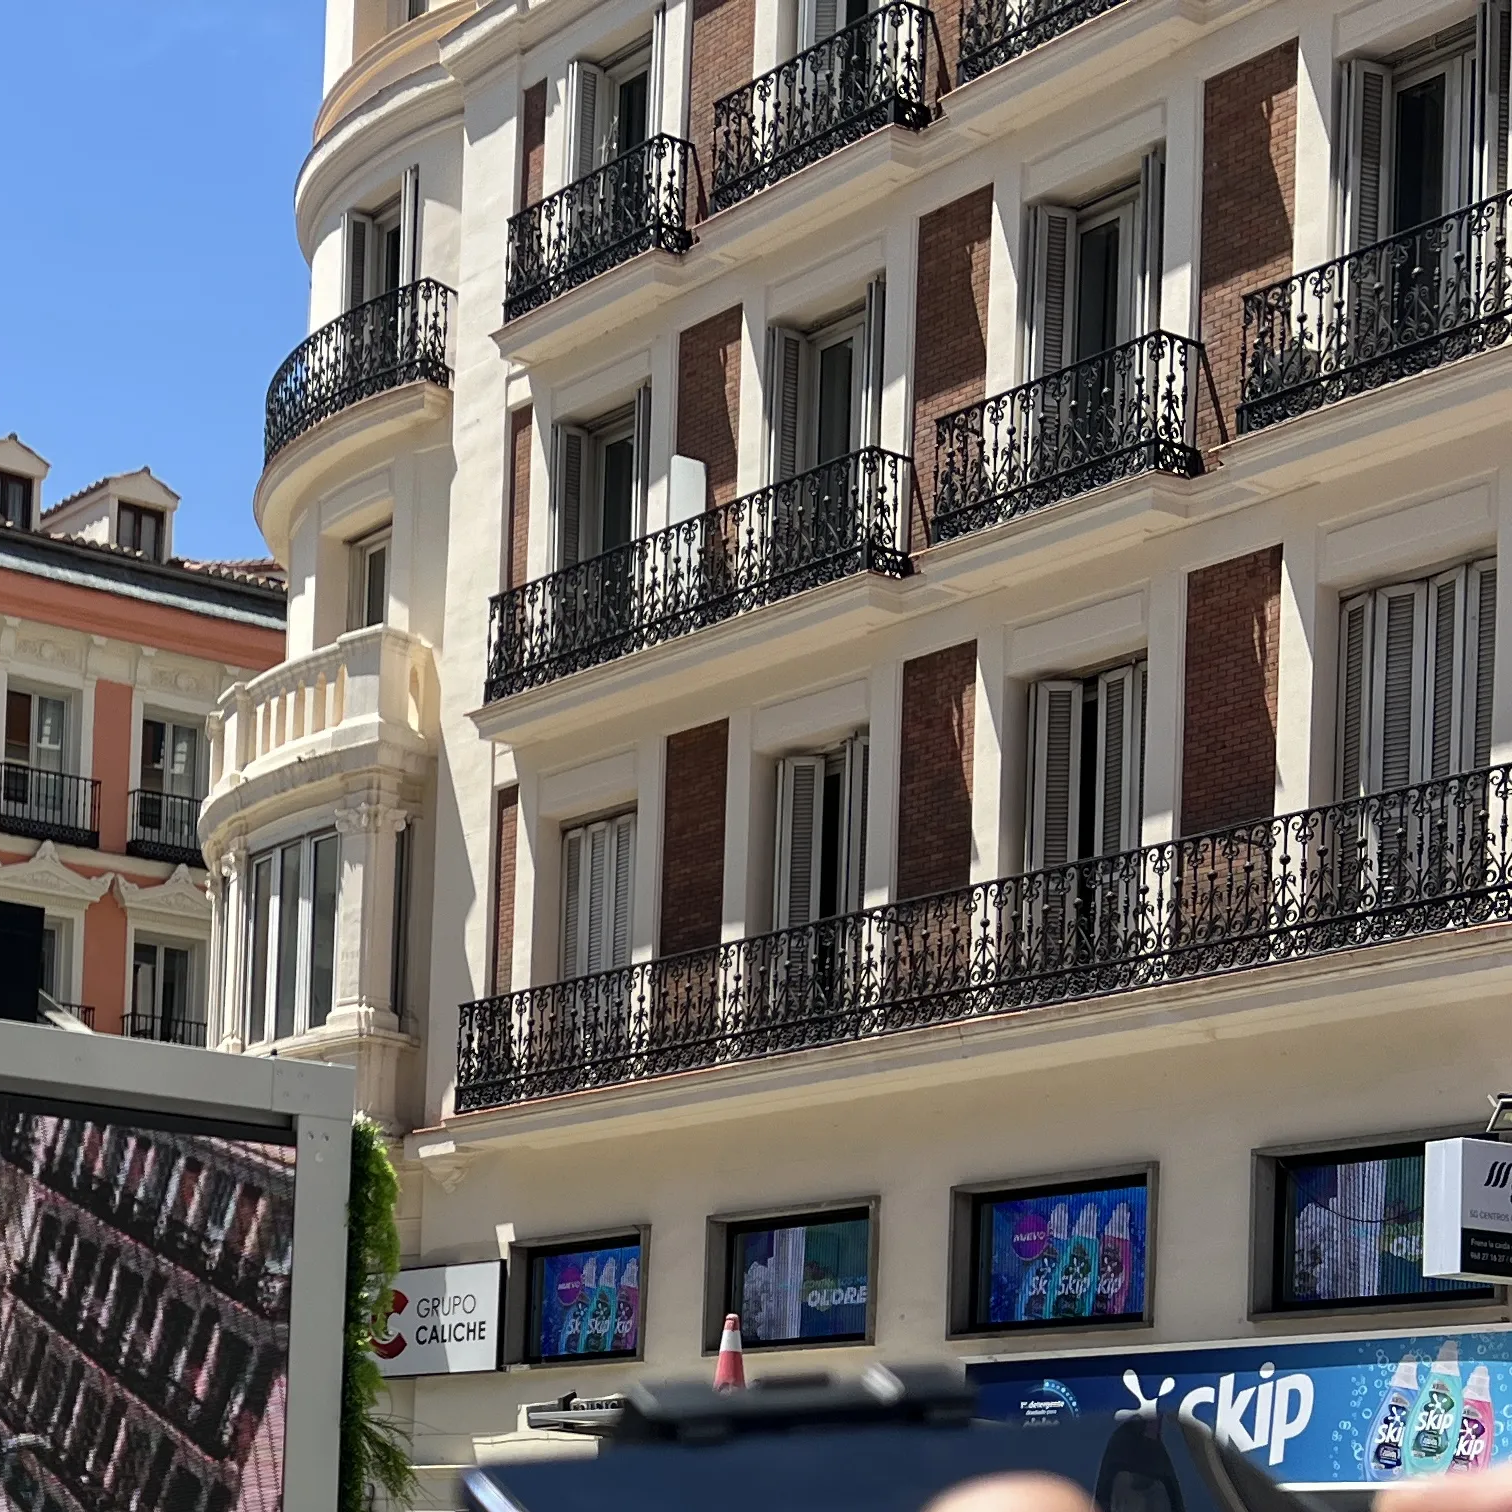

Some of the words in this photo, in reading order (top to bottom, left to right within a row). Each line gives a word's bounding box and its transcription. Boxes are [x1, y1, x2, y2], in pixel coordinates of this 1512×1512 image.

[1098, 1272, 1124, 1298] kip
[416, 1294, 476, 1318] GRUPO
[415, 1320, 486, 1345] CALICHE
[1455, 1434, 1485, 1460] kip
